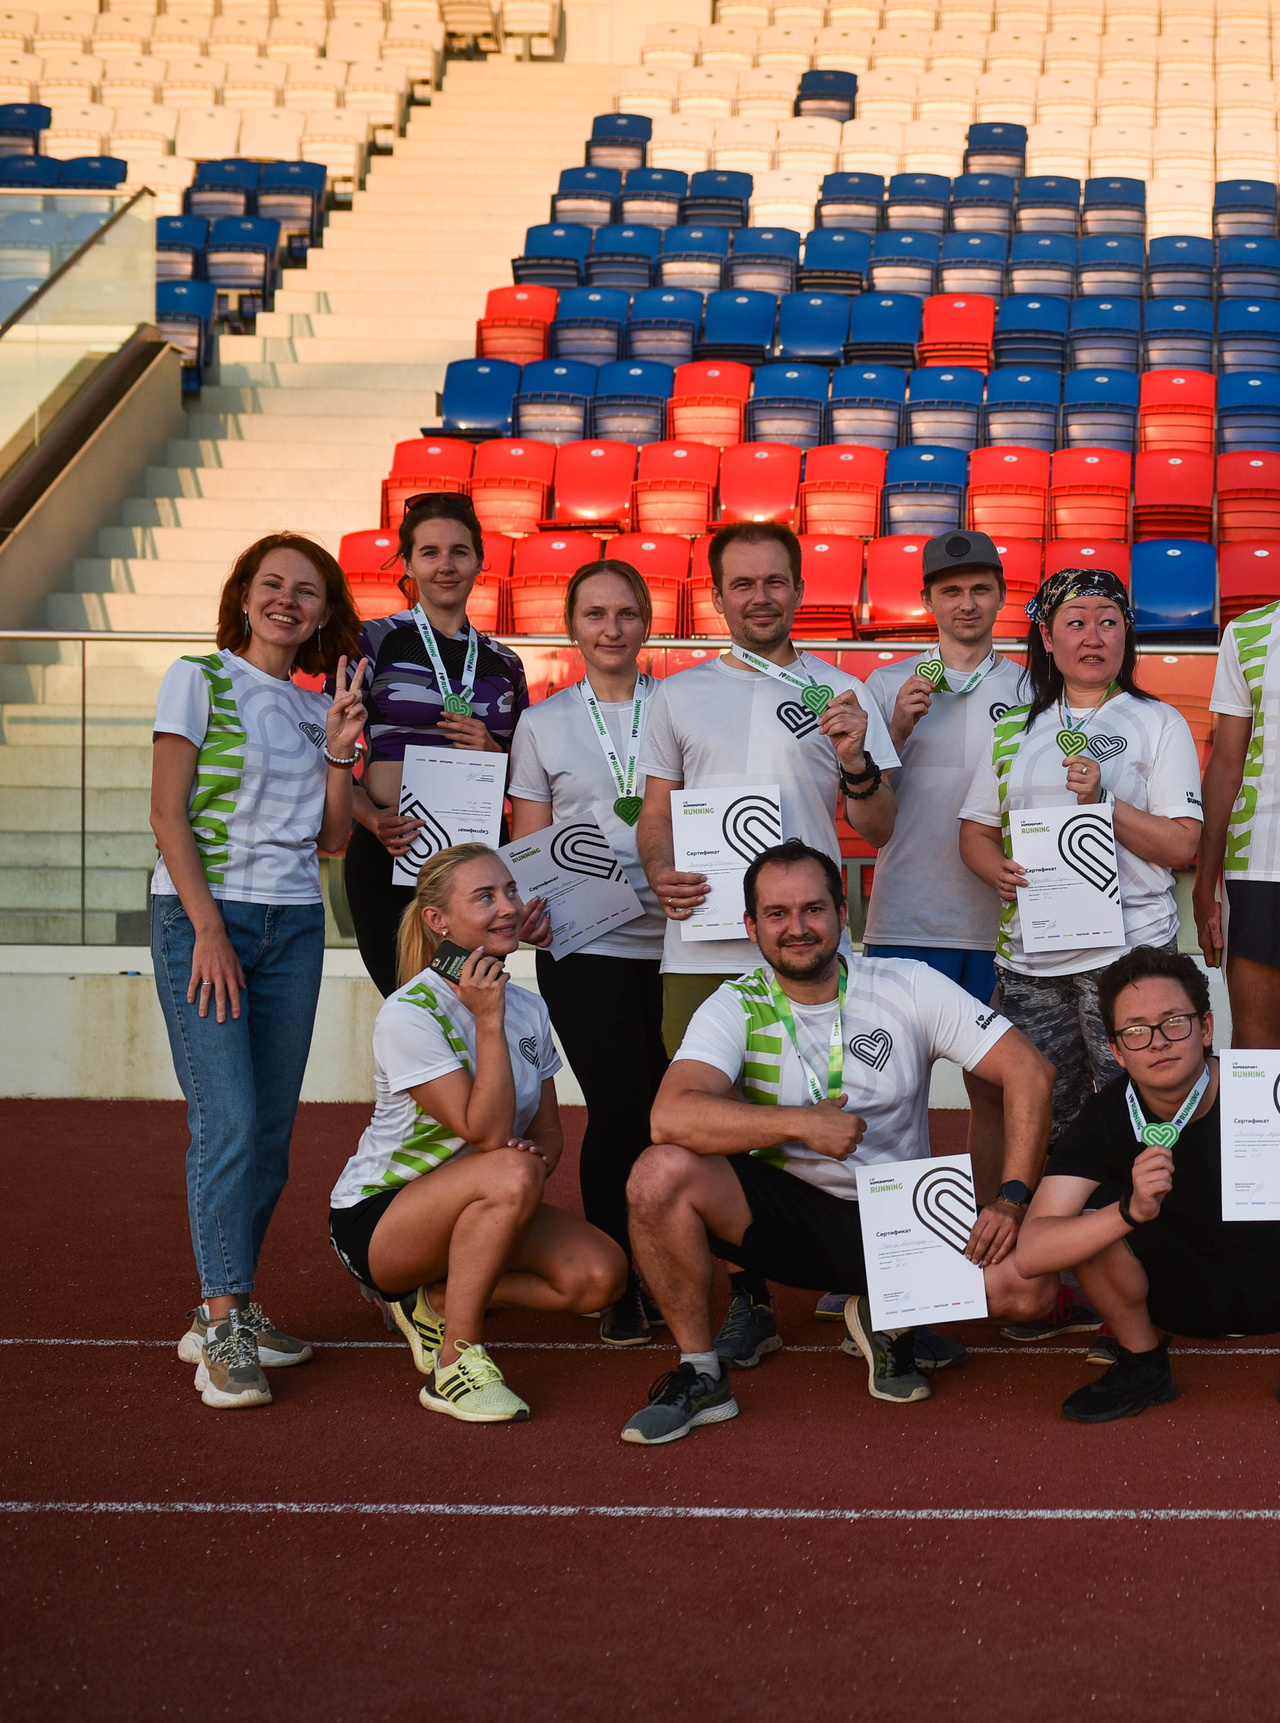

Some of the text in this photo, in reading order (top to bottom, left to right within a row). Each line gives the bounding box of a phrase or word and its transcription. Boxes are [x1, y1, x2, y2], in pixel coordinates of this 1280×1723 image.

[422, 630, 438, 658] RUNNING
[748, 655, 770, 670] RUNNING
[590, 705, 607, 736] RUNNING
[632, 699, 642, 729] RUNNING
[626, 755, 636, 789] RUNNING
[683, 807, 715, 816] RUNNING
[1021, 826, 1050, 834] RUNNING
[511, 847, 541, 863] RUNNING
[1025, 866, 1057, 874] Сертификат
[528, 876, 560, 893] Сертификат
[1232, 1070, 1266, 1078] RUNNING
[1179, 1089, 1200, 1121] RUNNING
[1131, 1101, 1144, 1130] RUNNING
[1233, 1117, 1270, 1125] Сертификат
[870, 1183, 904, 1194] RUNNING
[875, 1227, 912, 1238] Сертификат
